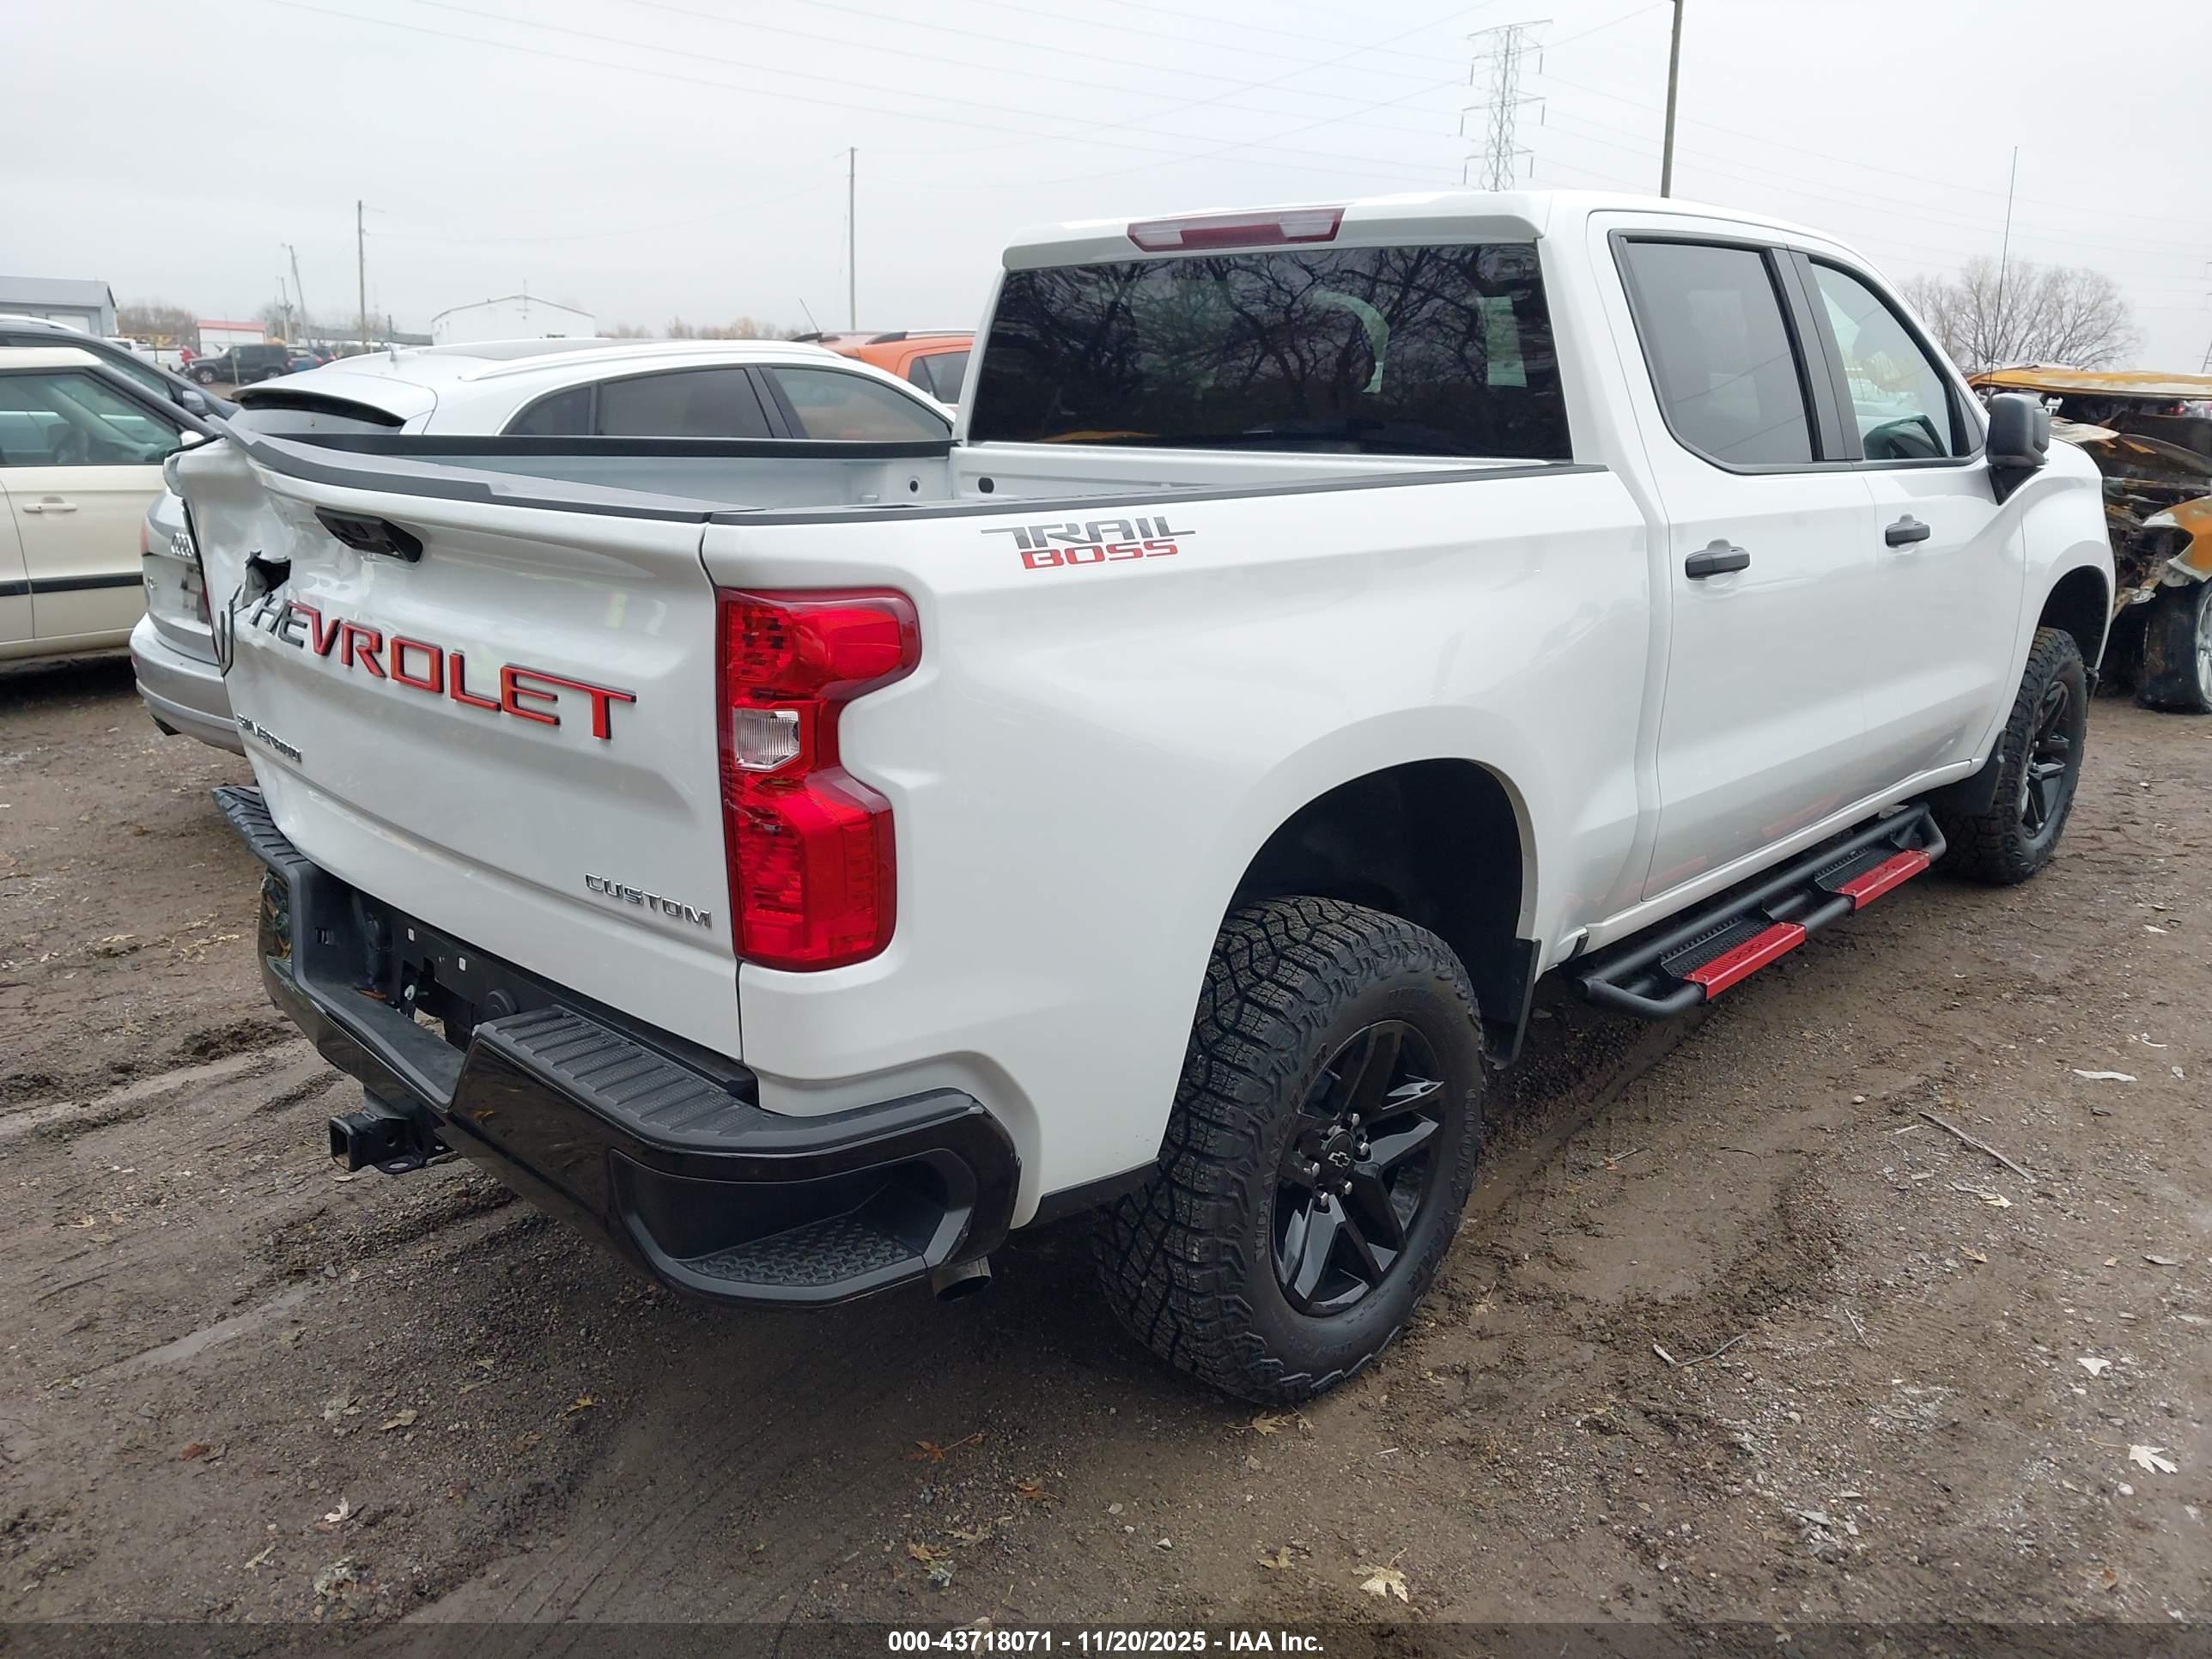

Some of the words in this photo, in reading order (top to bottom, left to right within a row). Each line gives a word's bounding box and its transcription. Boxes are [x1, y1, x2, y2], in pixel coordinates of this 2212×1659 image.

[981, 516, 1195, 550] TRAIL
[1020, 538, 1178, 569] BOSS
[585, 872, 712, 928] CUSTOM
